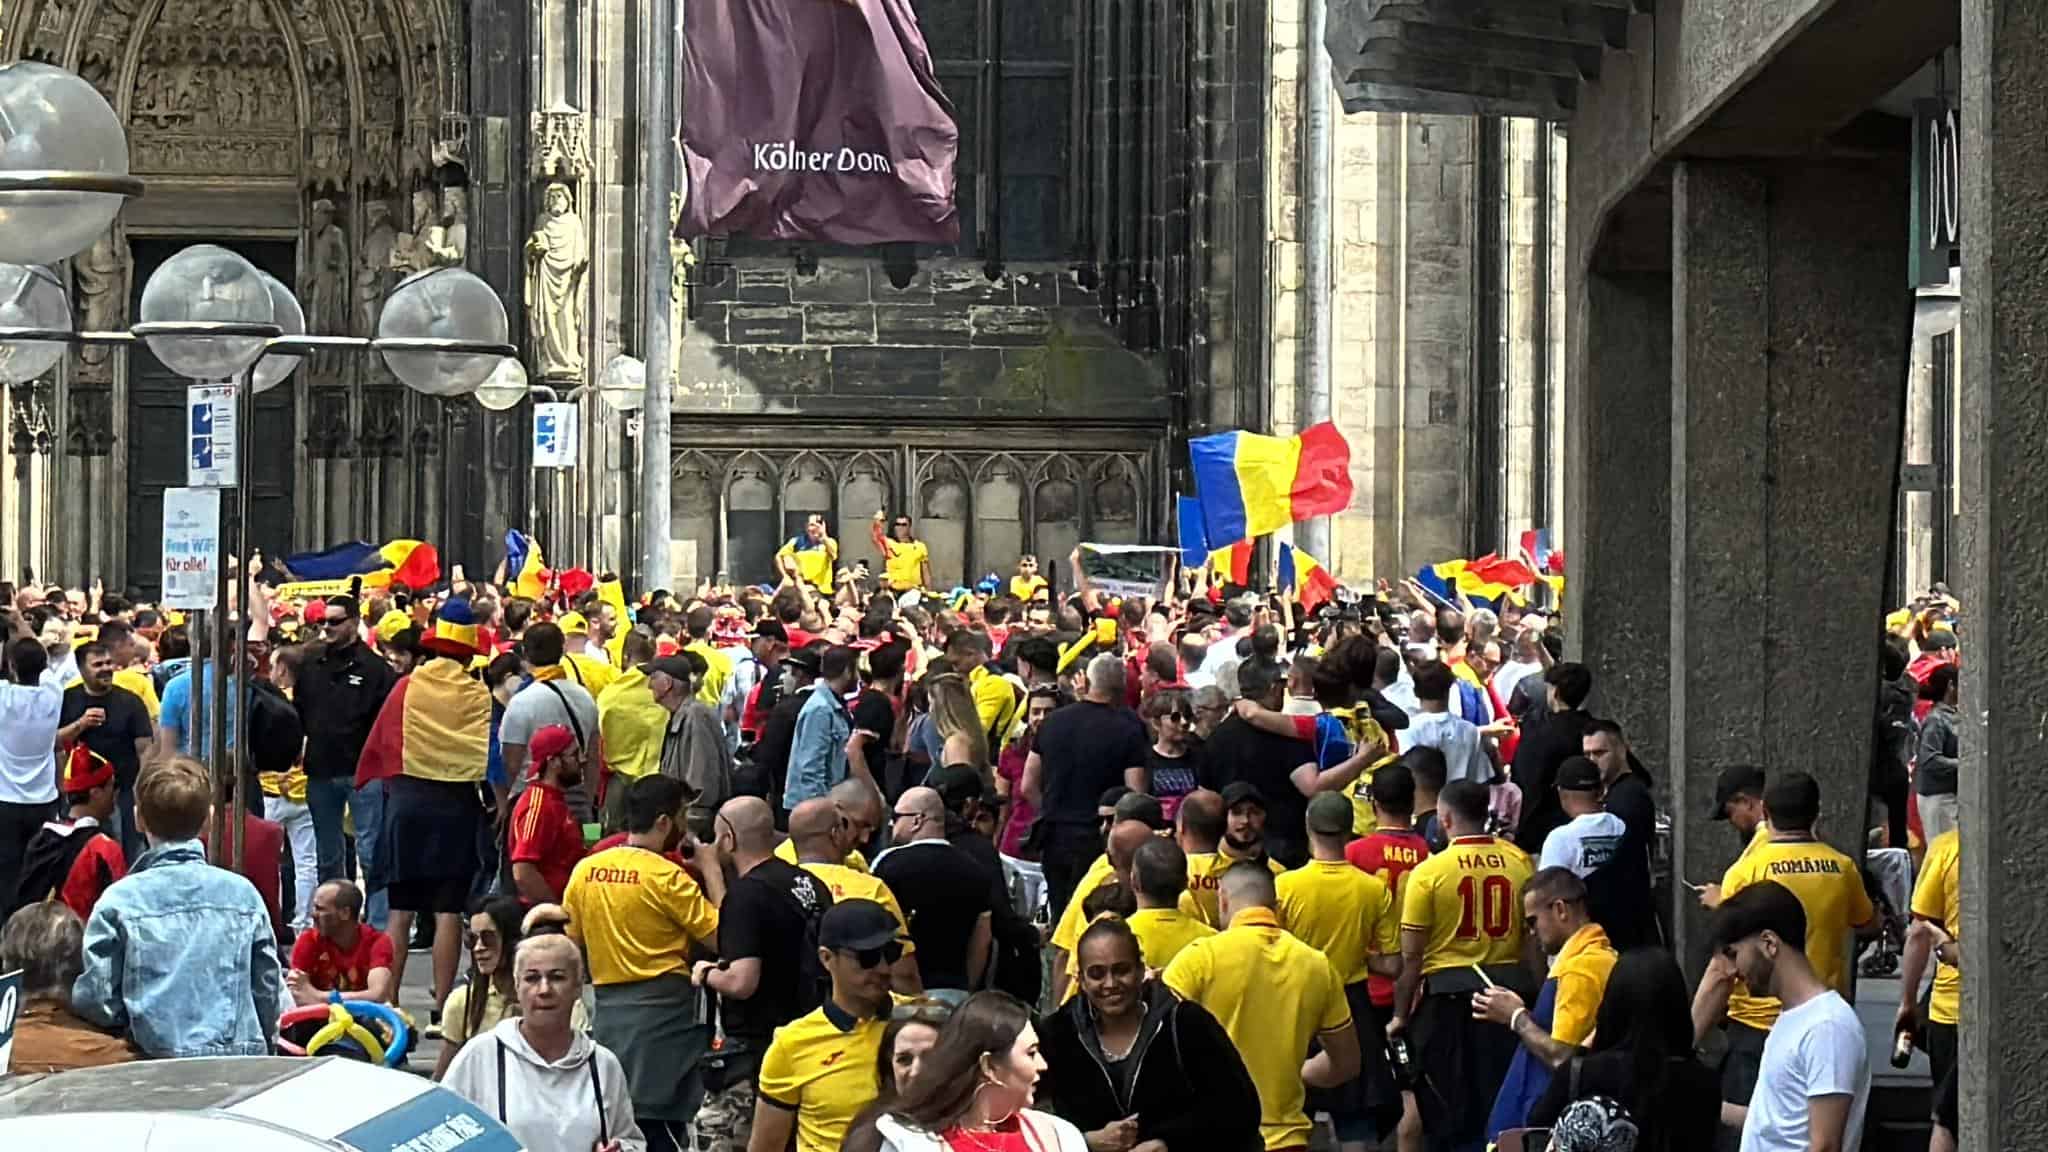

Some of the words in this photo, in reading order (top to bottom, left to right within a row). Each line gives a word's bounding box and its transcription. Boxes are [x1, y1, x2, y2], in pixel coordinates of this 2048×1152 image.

[754, 139, 834, 171] Kölner
[837, 147, 891, 173] Dom
[1383, 844, 1418, 864] HAGI
[1458, 854, 1506, 869] HAGI
[1771, 857, 1841, 875] ROMÂNIA
[1456, 875, 1513, 941] 10
